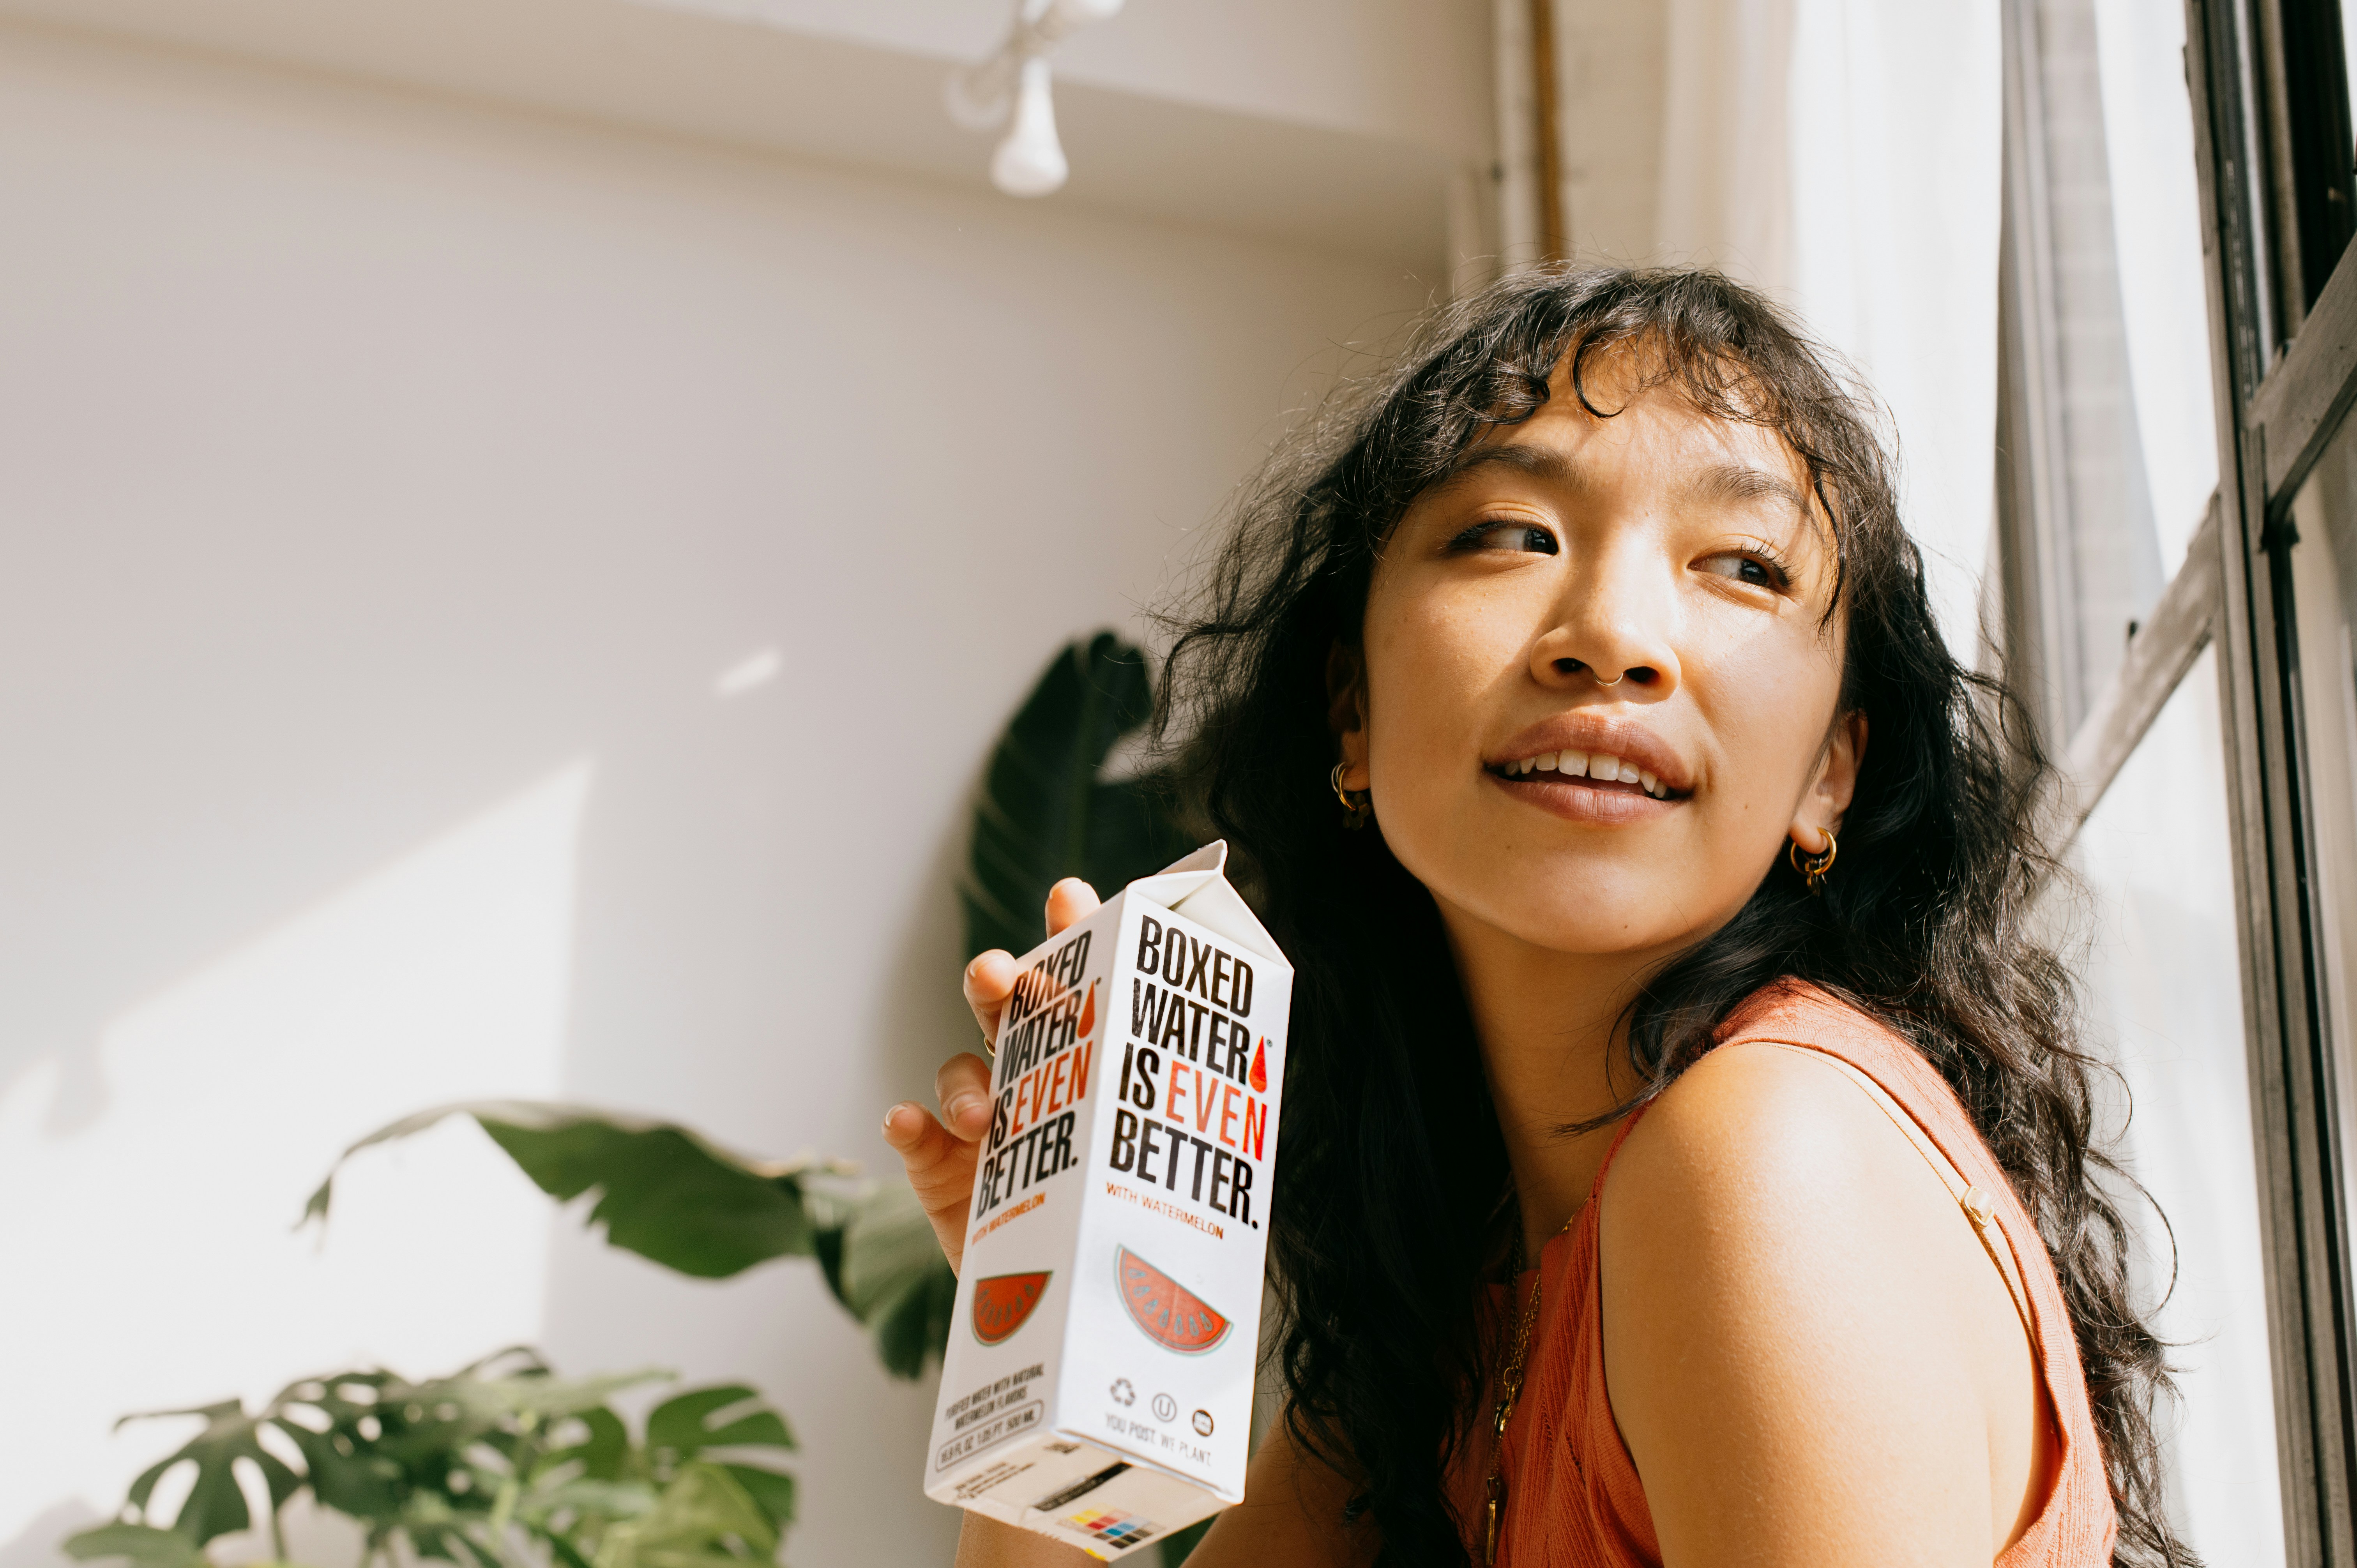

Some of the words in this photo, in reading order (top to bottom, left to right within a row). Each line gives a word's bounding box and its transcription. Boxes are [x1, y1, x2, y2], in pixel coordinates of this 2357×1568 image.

[1007, 930, 1091, 1031] BOXED
[1136, 915, 1253, 1018] BOXED
[999, 990, 1082, 1091] WATER
[1132, 978, 1250, 1085] WATER
[987, 1087, 1013, 1156] IS
[1011, 1040, 1093, 1136] EVEN
[1119, 1042, 1159, 1110] IS
[1166, 1059, 1267, 1162] EVEN
[976, 1111, 1078, 1221] BETTER.
[989, 1191, 1046, 1233] WATERMELON
[1106, 1182, 1137, 1203] WITH
[1141, 1195, 1223, 1240] WATERMELON
[1110, 1108, 1258, 1229] BETTER.
